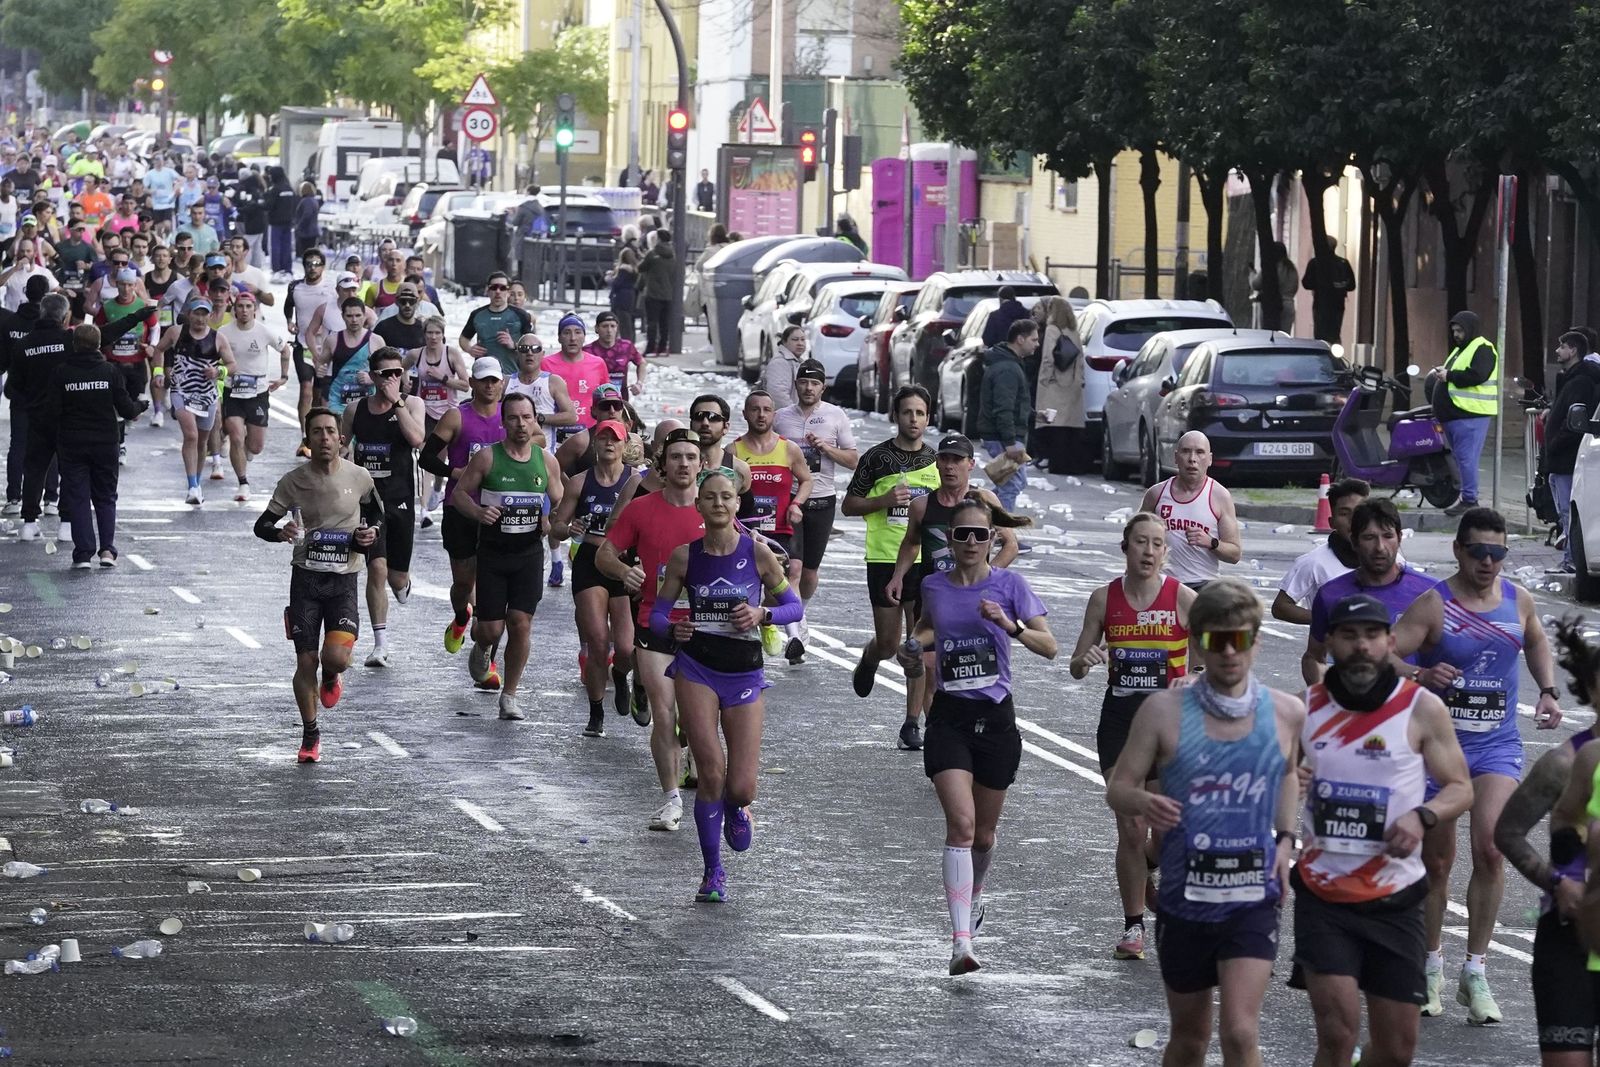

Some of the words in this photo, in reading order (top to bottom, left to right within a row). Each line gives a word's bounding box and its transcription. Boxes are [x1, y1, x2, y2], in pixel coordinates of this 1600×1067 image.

[469, 118, 490, 130] 30
[25, 343, 65, 357] VOLUNTEER
[65, 381, 109, 391] VOLUNTEER
[1261, 444, 1288, 454] 4249
[1291, 443, 1312, 453] GBR
[1415, 438, 1434, 447] cabify
[363, 461, 382, 469] MATT
[501, 516, 520, 525] JOSE
[712, 587, 742, 596] ZURICH
[1136, 610, 1177, 626] SOPH
[1108, 624, 1174, 637] SERPENTINE
[956, 637, 989, 648] ZURICH
[1129, 651, 1161, 659] ZURICH
[952, 664, 986, 679] YENTL
[1120, 675, 1158, 687] SOPHIE
[1469, 679, 1502, 688] ZURICH
[1336, 786, 1380, 800] ZURICH
[1325, 820, 1368, 838] TIAGO
[1215, 836, 1257, 848] ZURICH
[1185, 870, 1265, 888] ALEXANDRE
